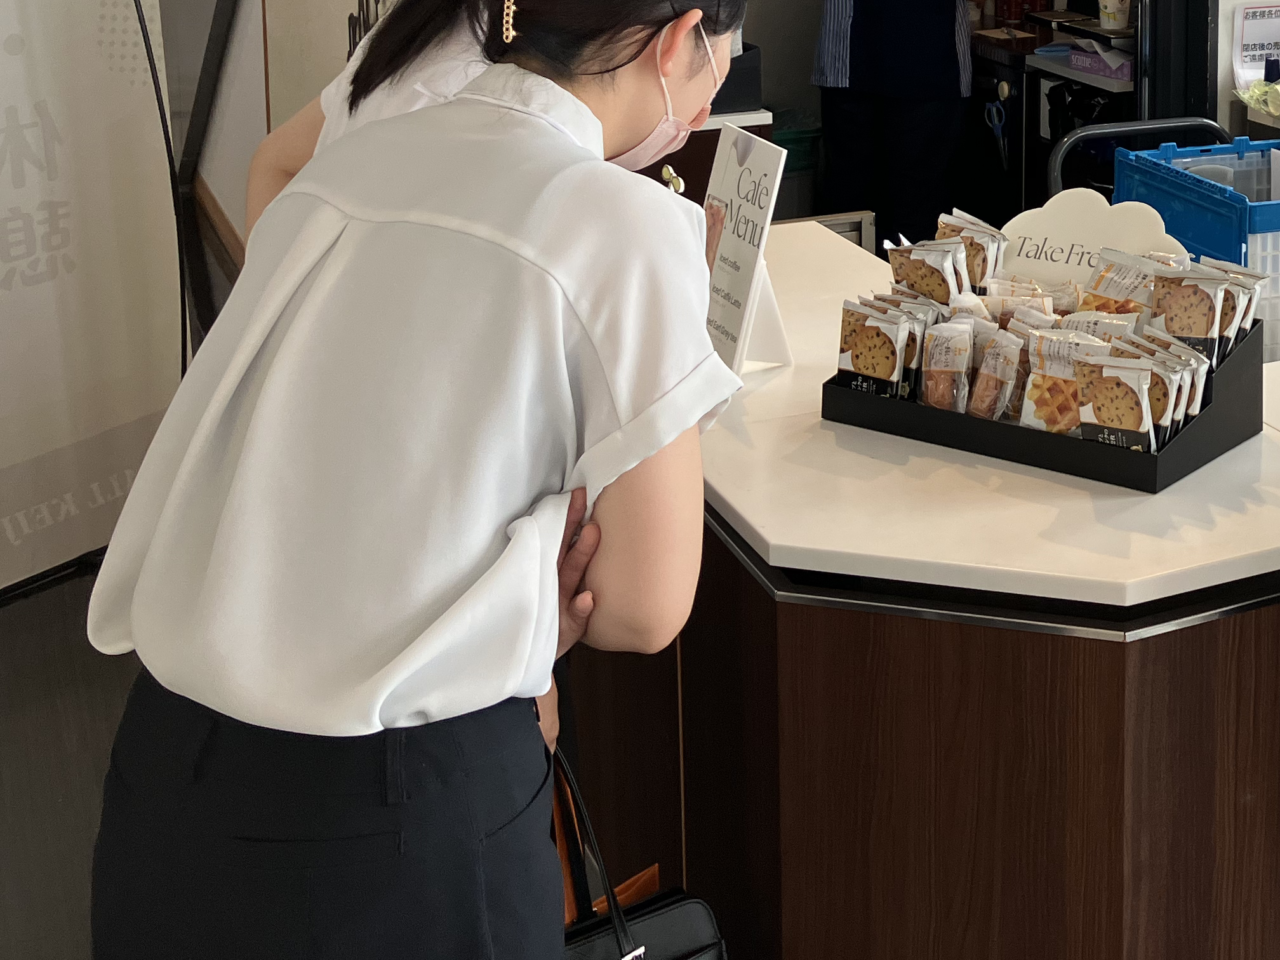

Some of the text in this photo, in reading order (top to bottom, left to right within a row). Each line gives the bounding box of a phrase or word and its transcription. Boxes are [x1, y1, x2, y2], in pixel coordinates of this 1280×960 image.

[737, 167, 769, 210] Cafe
[724, 198, 764, 250] Menu
[1016, 235, 1100, 268] Take Fre
